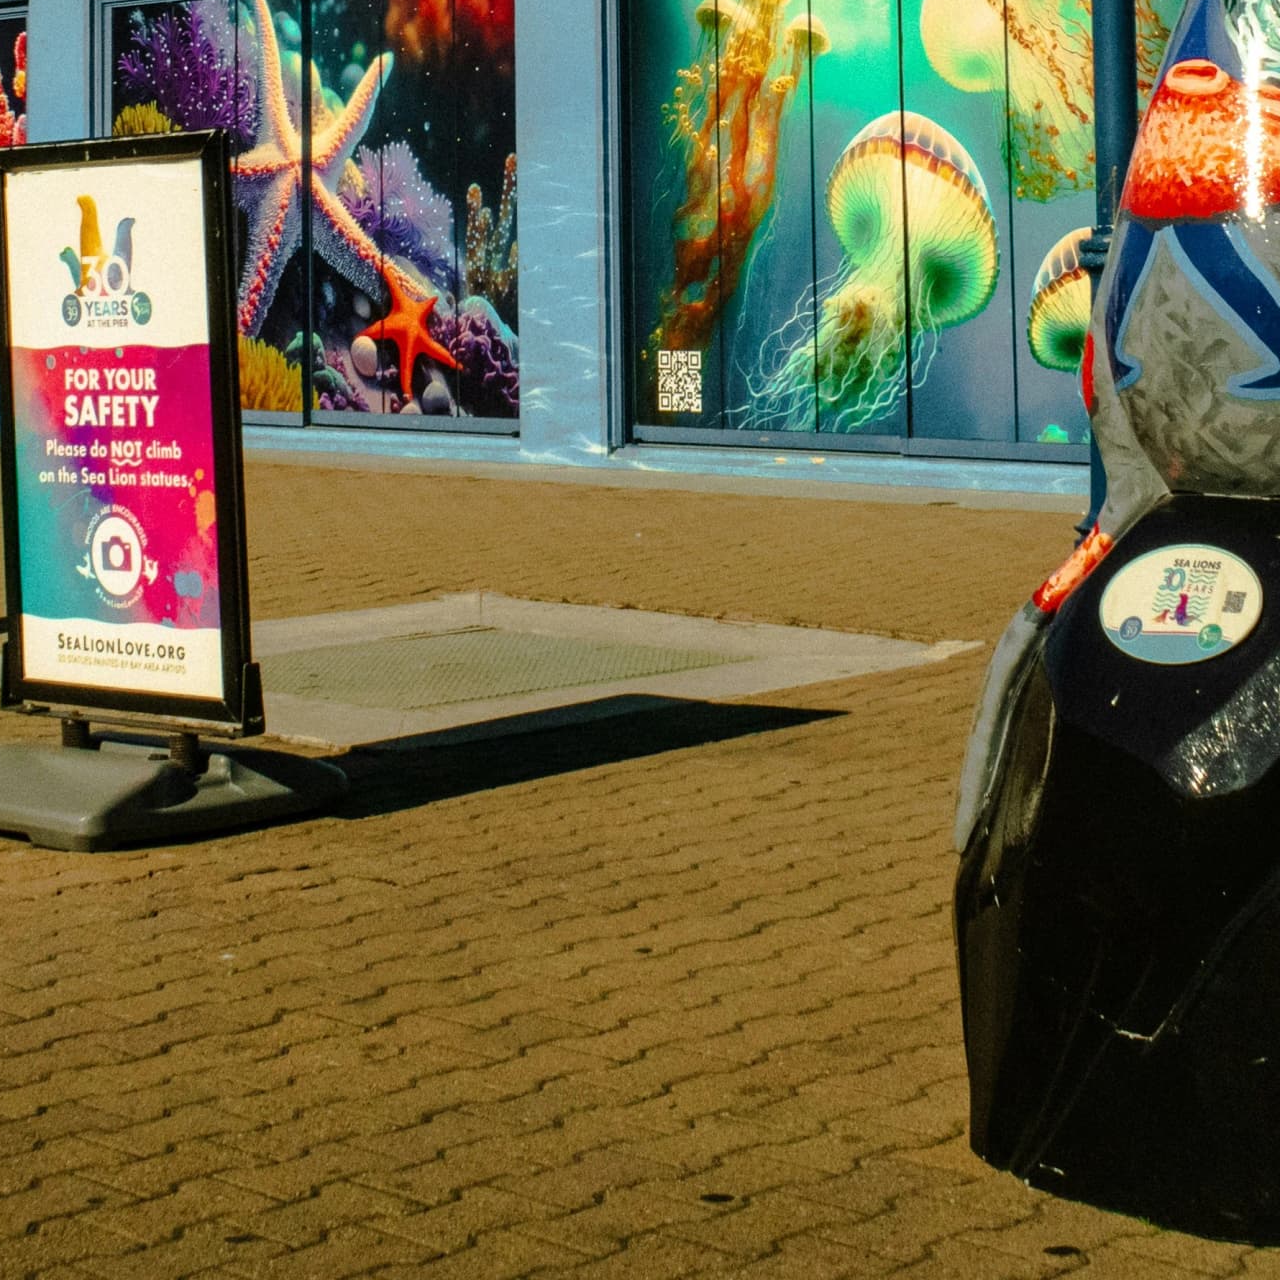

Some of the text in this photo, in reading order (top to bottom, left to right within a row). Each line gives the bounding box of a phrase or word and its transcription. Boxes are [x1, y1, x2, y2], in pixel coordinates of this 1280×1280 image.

[80, 256, 129, 297] 30
[85, 300, 128, 317] YEARS
[65, 368, 157, 391] FOR YOUR
[64, 395, 160, 427] SAFETY
[46, 439, 182, 459] Please do NOT climb
[39, 466, 193, 488] on the Sea Lion statues.
[1173, 558, 1222, 570] SEA LIONS
[1158, 567, 1187, 592] 30
[1183, 583, 1215, 594] EARS
